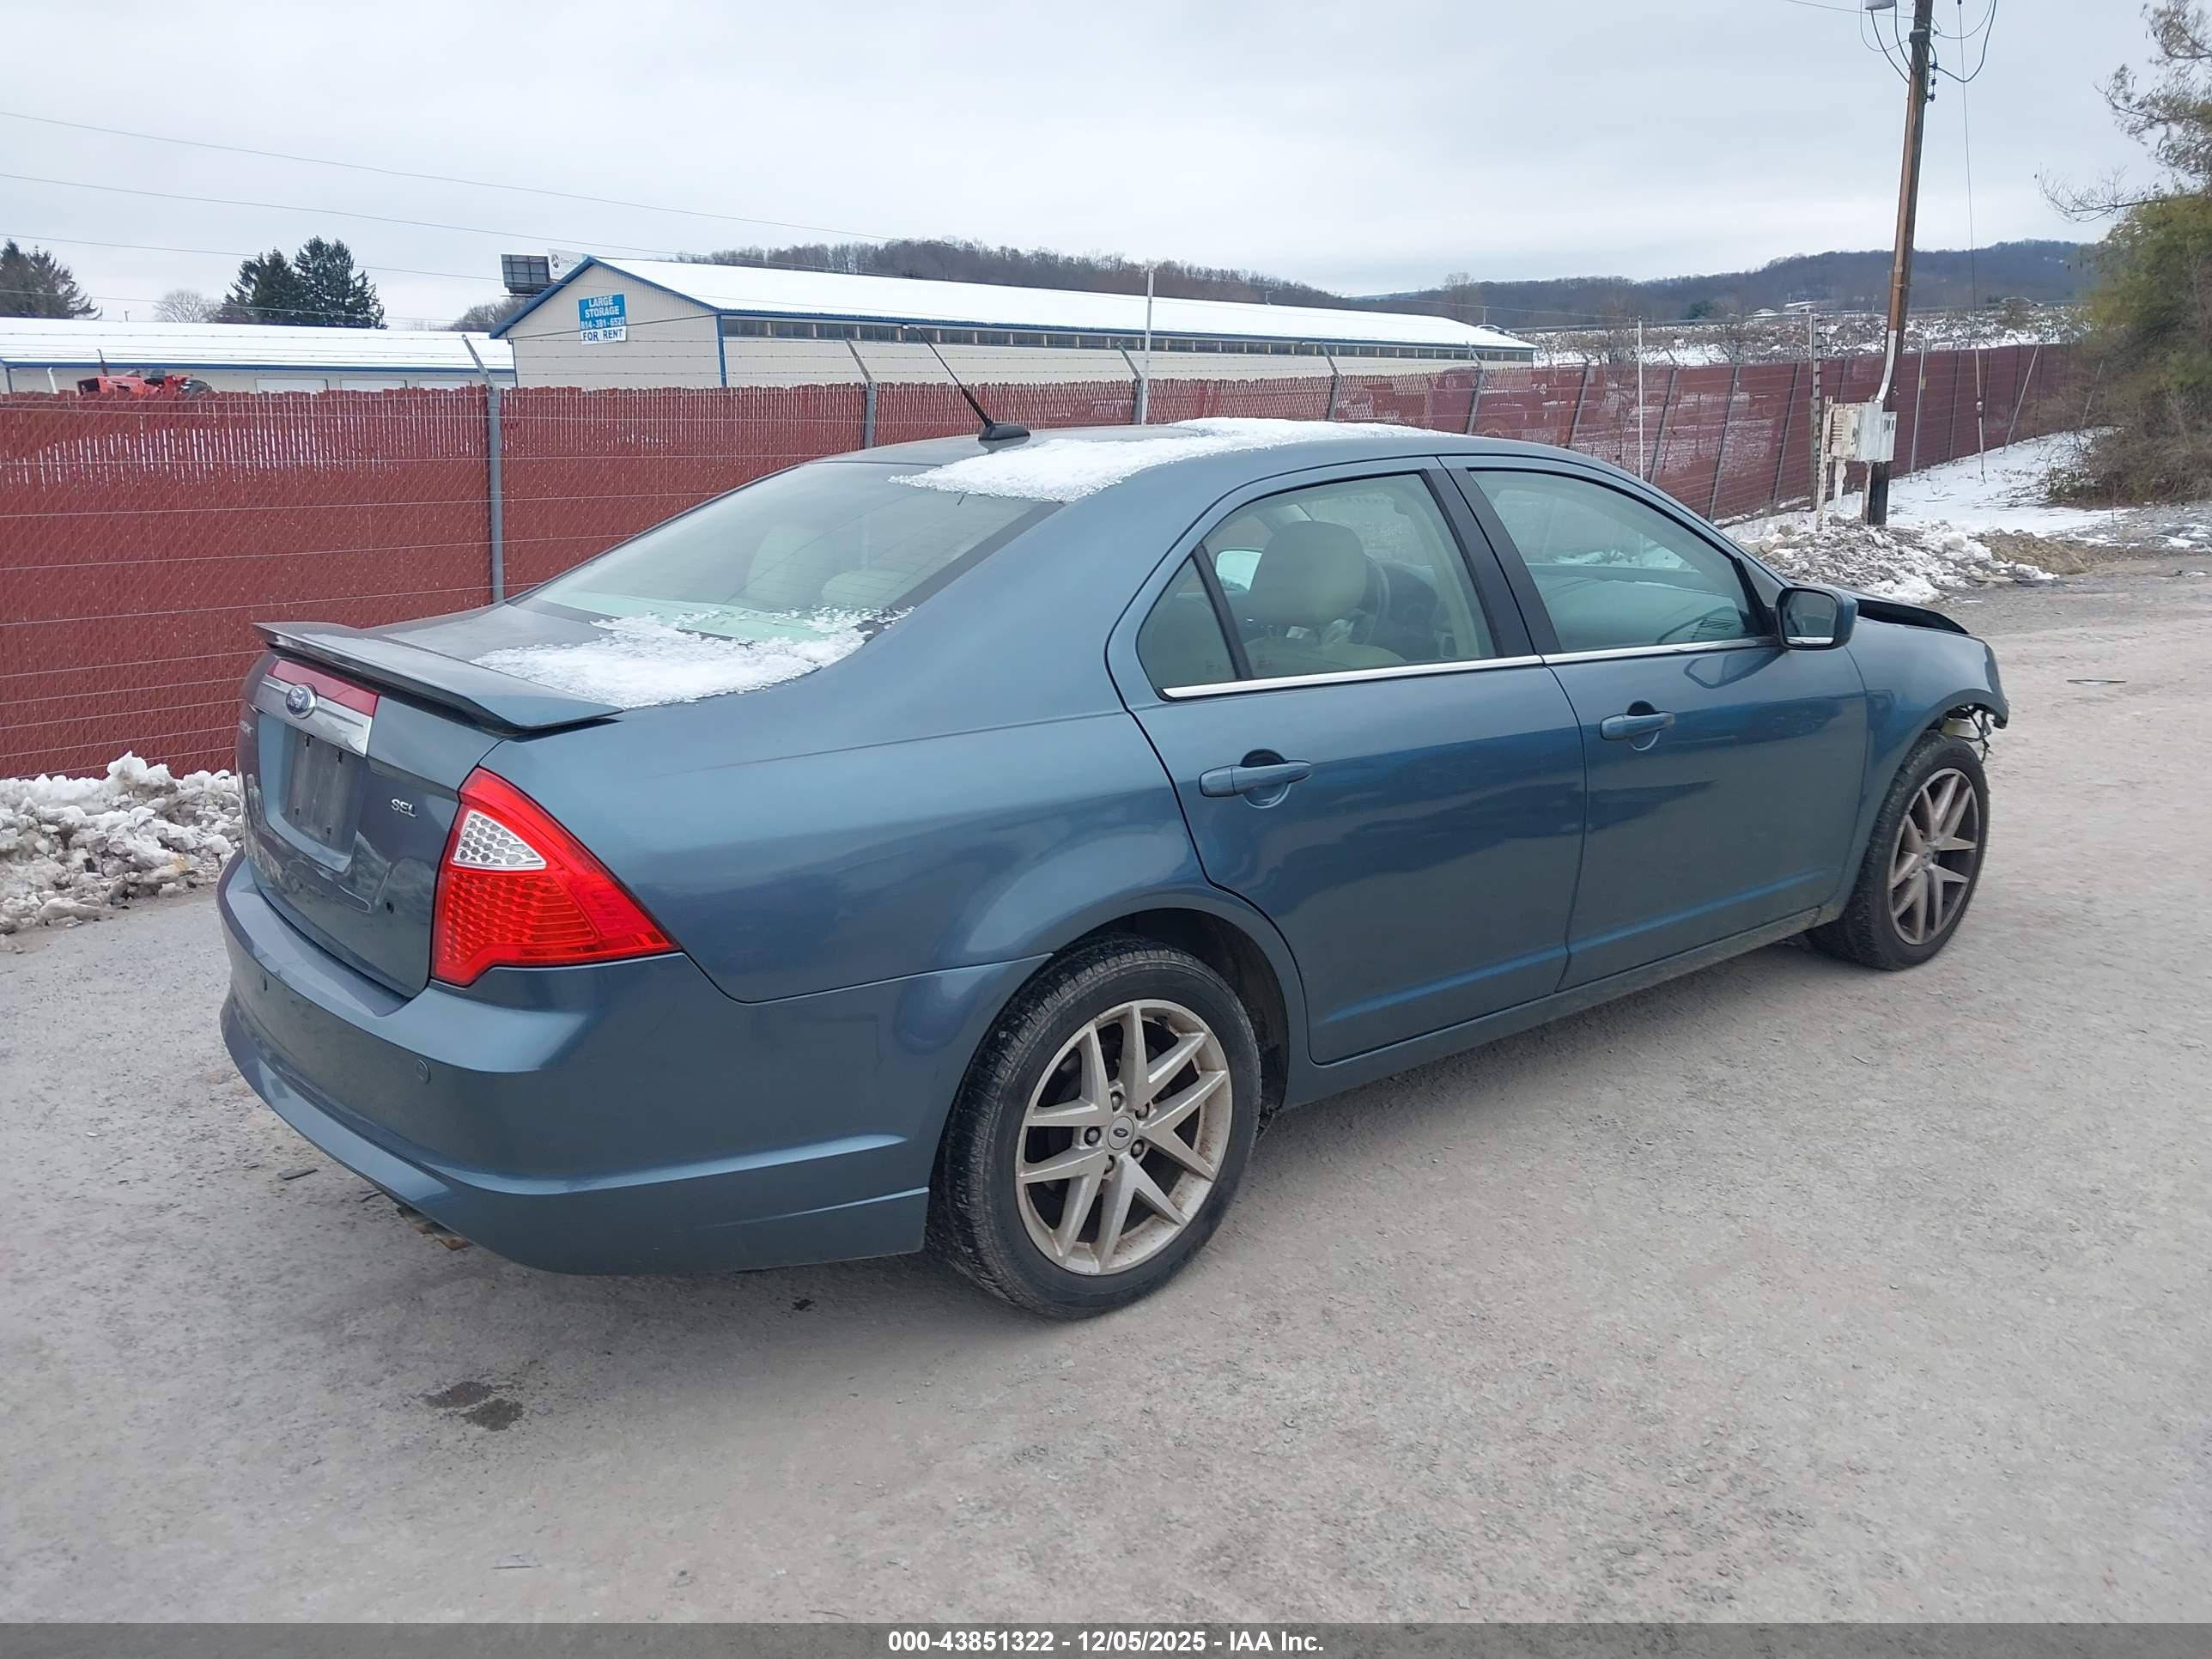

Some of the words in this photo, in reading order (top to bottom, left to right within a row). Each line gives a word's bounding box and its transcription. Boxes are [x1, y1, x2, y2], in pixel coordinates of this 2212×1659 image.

[588, 296, 614, 307] LARGE
[585, 306, 620, 319] STORAGE
[583, 331, 599, 342] FOR
[603, 329, 623, 340] RENT
[391, 799, 416, 817] SEL
